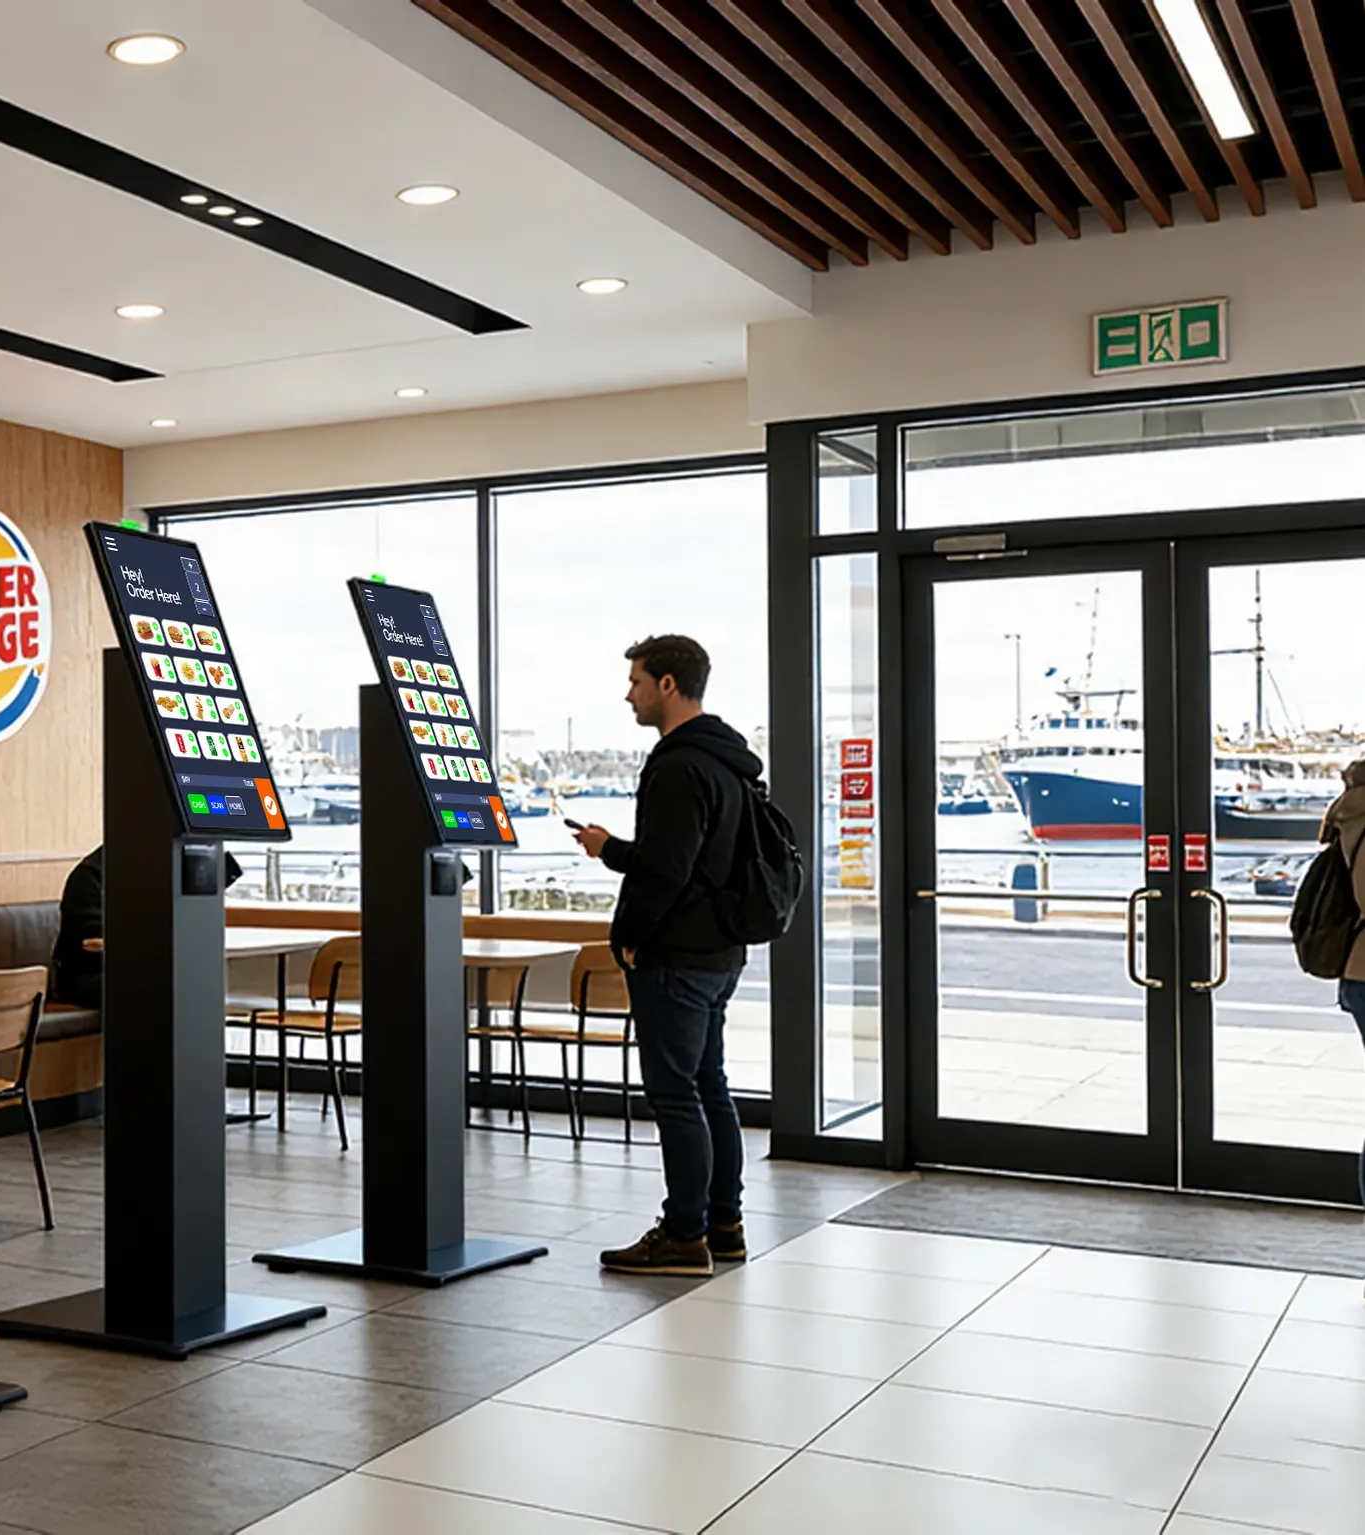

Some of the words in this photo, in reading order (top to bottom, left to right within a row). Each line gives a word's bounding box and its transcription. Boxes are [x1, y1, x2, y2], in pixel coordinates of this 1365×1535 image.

[120, 565, 145, 586] Hey!
[126, 582, 155, 601] Order
[155, 587, 183, 606] Here!
[194, 582, 201, 593] 2
[382, 628, 404, 643] Order
